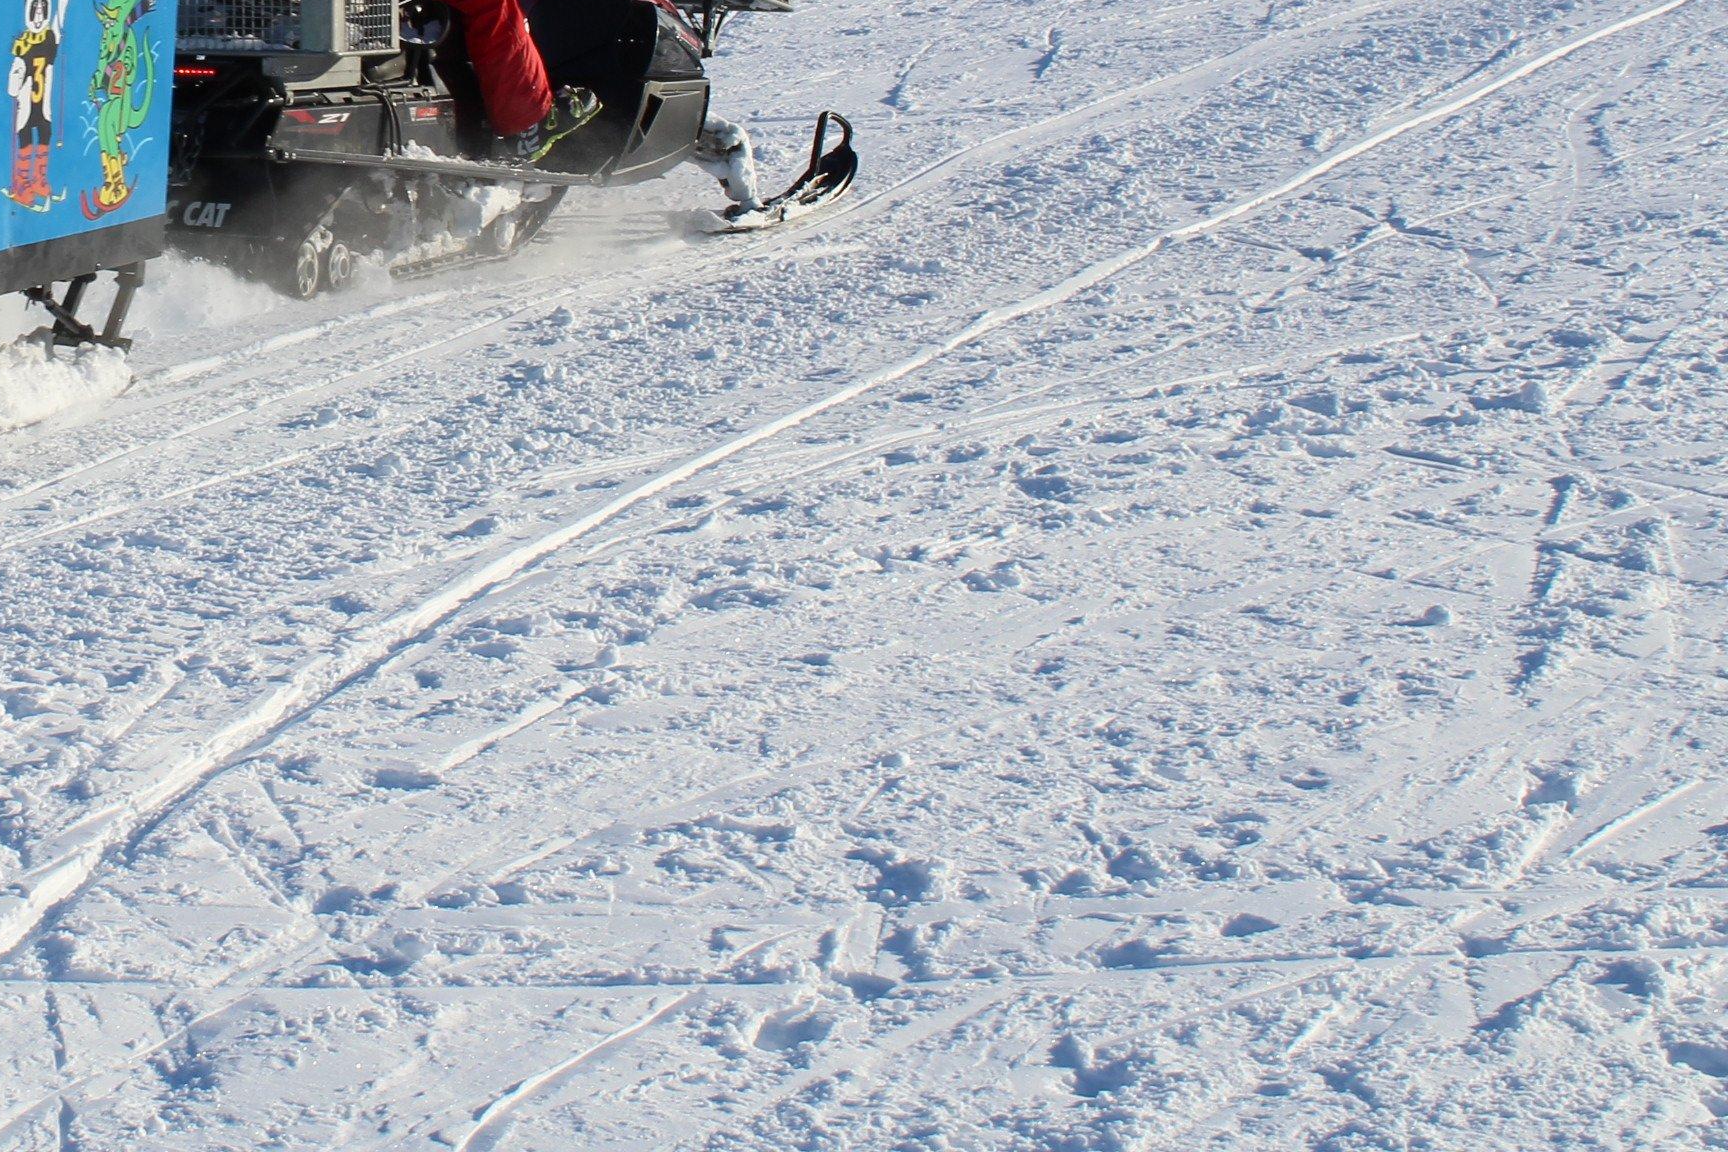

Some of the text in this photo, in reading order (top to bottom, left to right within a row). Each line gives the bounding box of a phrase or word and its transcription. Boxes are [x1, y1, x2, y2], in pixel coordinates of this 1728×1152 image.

[32, 57, 46, 104] 3
[110, 60, 125, 95] 2
[183, 201, 232, 227] CAT
